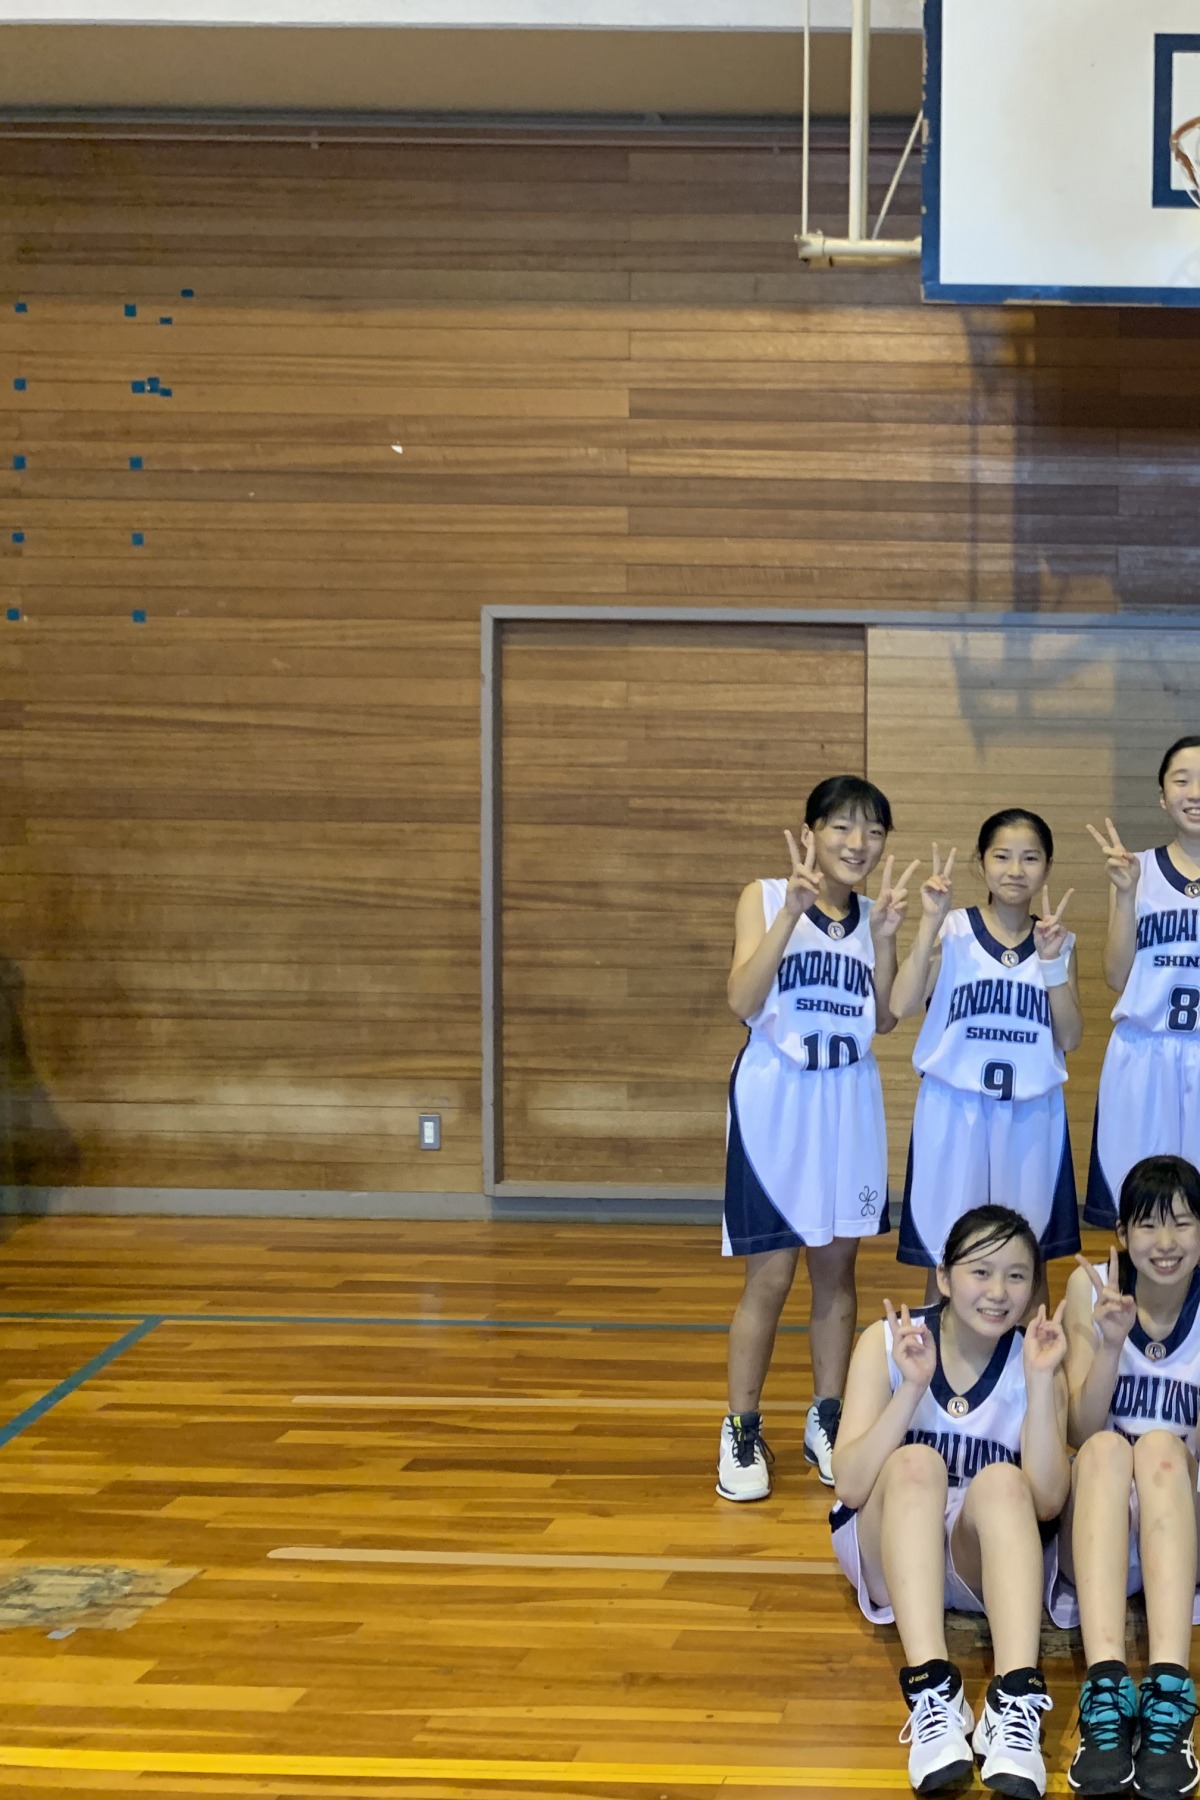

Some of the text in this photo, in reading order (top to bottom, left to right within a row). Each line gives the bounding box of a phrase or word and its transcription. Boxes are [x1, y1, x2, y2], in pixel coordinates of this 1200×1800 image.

[796, 999, 863, 1017] SHINGU
[965, 1026, 1038, 1044] SHINGU
[801, 1030, 861, 1071] 10
[980, 1059, 1016, 1101] 9
